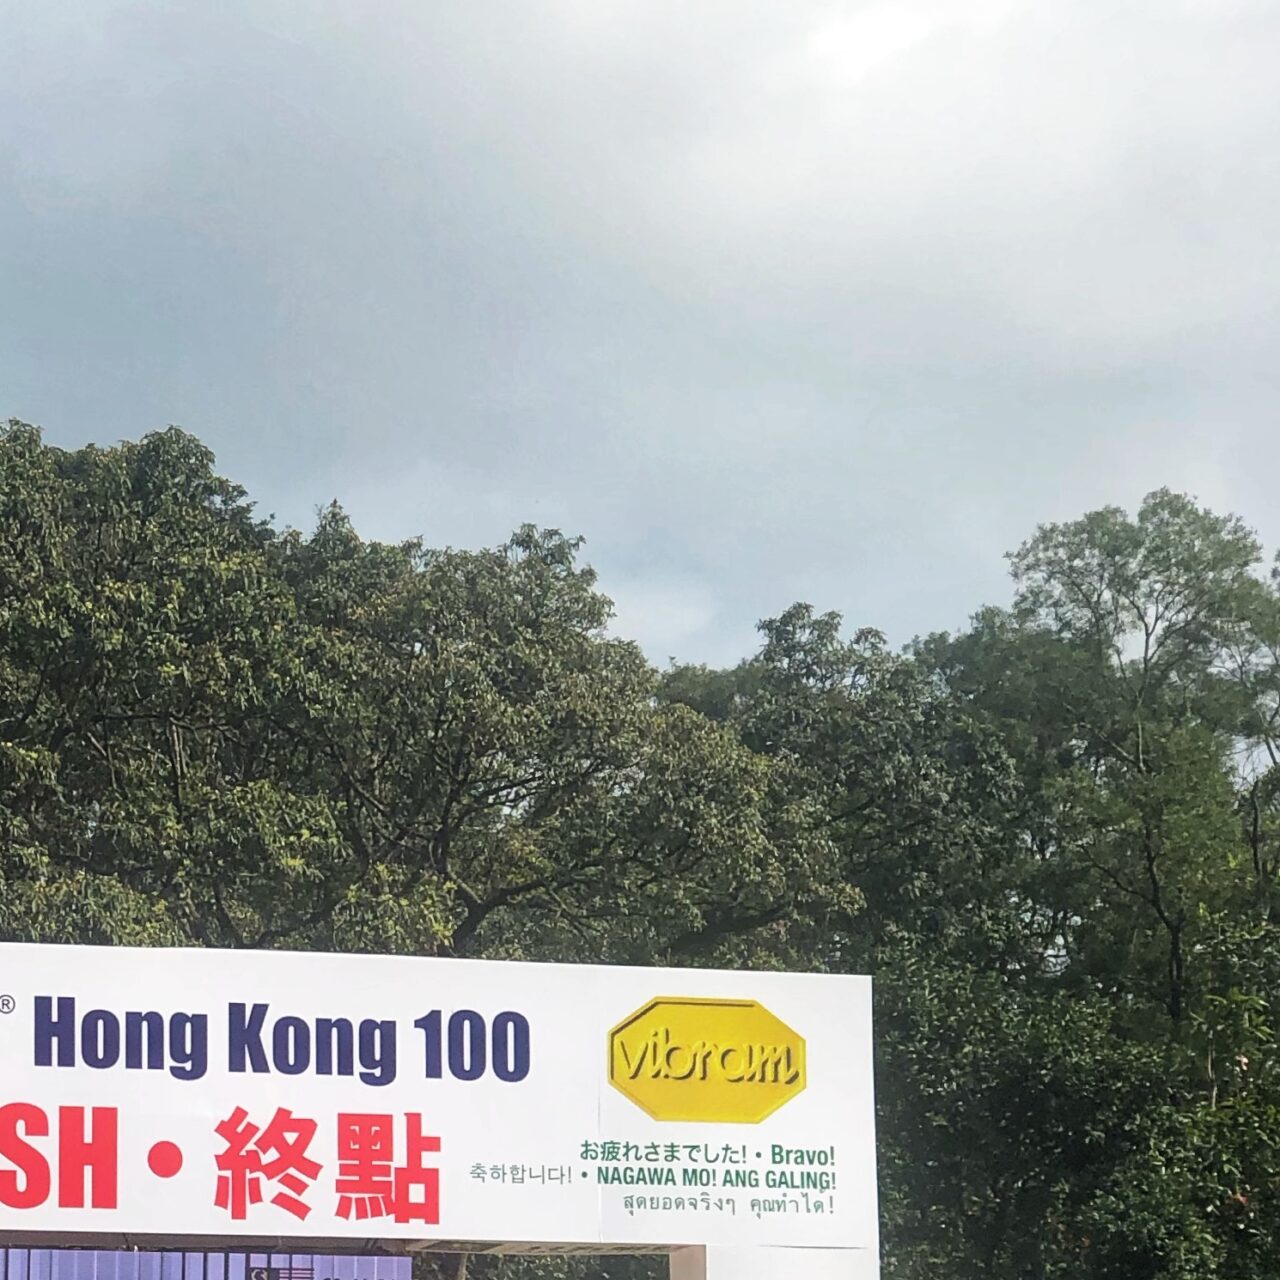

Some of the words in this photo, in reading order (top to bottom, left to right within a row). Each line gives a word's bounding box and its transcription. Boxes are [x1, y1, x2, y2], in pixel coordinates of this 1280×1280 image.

[34, 996, 208, 1081] Hong
[229, 1002, 397, 1087] Kong
[414, 1009, 530, 1082] 100
[214, 1105, 442, 1225] 終點
[470, 1163, 573, 1185] 축하합니다!
[597, 1166, 677, 1187] NAGAWA
[682, 1168, 718, 1188] MO!
[722, 1168, 759, 1188] ANG
[765, 1169, 837, 1191] GALING!
[771, 1144, 835, 1167] Bravo!
